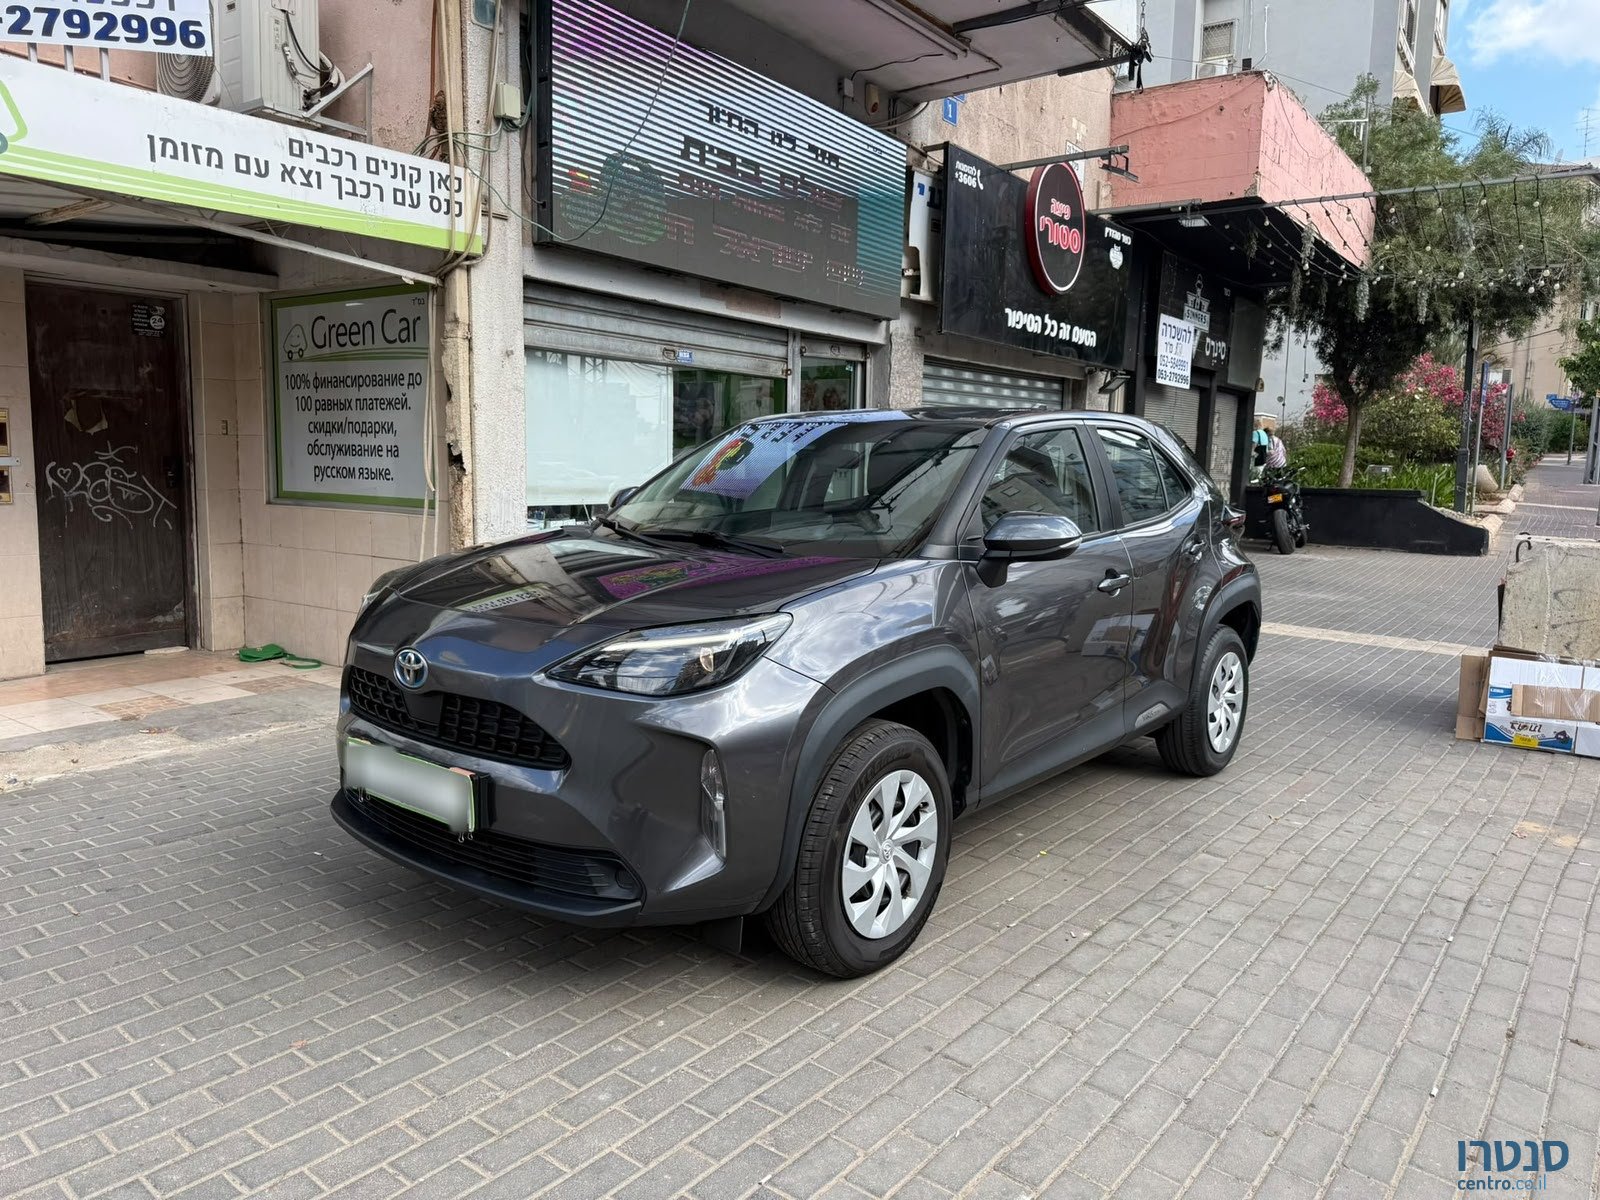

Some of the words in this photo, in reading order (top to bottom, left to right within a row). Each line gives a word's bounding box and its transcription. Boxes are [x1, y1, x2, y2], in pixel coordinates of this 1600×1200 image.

[0, 4, 206, 49] 2792996
[147, 133, 223, 170] מזומן
[288, 137, 357, 171] רכבים
[234, 152, 270, 179] עם
[280, 163, 322, 190] וצא
[365, 155, 421, 189] קונים
[331, 172, 384, 202] רכבך
[429, 169, 463, 194] כאן
[393, 187, 421, 209] עם
[429, 194, 463, 218] כנס
[1050, 198, 1072, 220] פיצה
[1039, 215, 1081, 254] סטורי
[311, 315, 375, 349] Green
[381, 308, 421, 344] Car
[1004, 307, 1042, 334] הסיפור
[1044, 313, 1058, 337] כל
[1059, 322, 1071, 341] זה
[1072, 326, 1097, 348] הטעם
[1161, 322, 1192, 344] להשכרה
[285, 373, 311, 391] 100%
[312, 371, 405, 393] финансирование
[407, 371, 423, 390] до
[295, 395, 312, 412] 100
[315, 396, 354, 415] равных
[355, 393, 412, 412] платежей.
[308, 417, 398, 437] скидки/подарки,
[307, 439, 384, 460] обслуживание
[385, 443, 400, 459] на
[313, 463, 356, 481] русском
[358, 467, 394, 482] языке.
